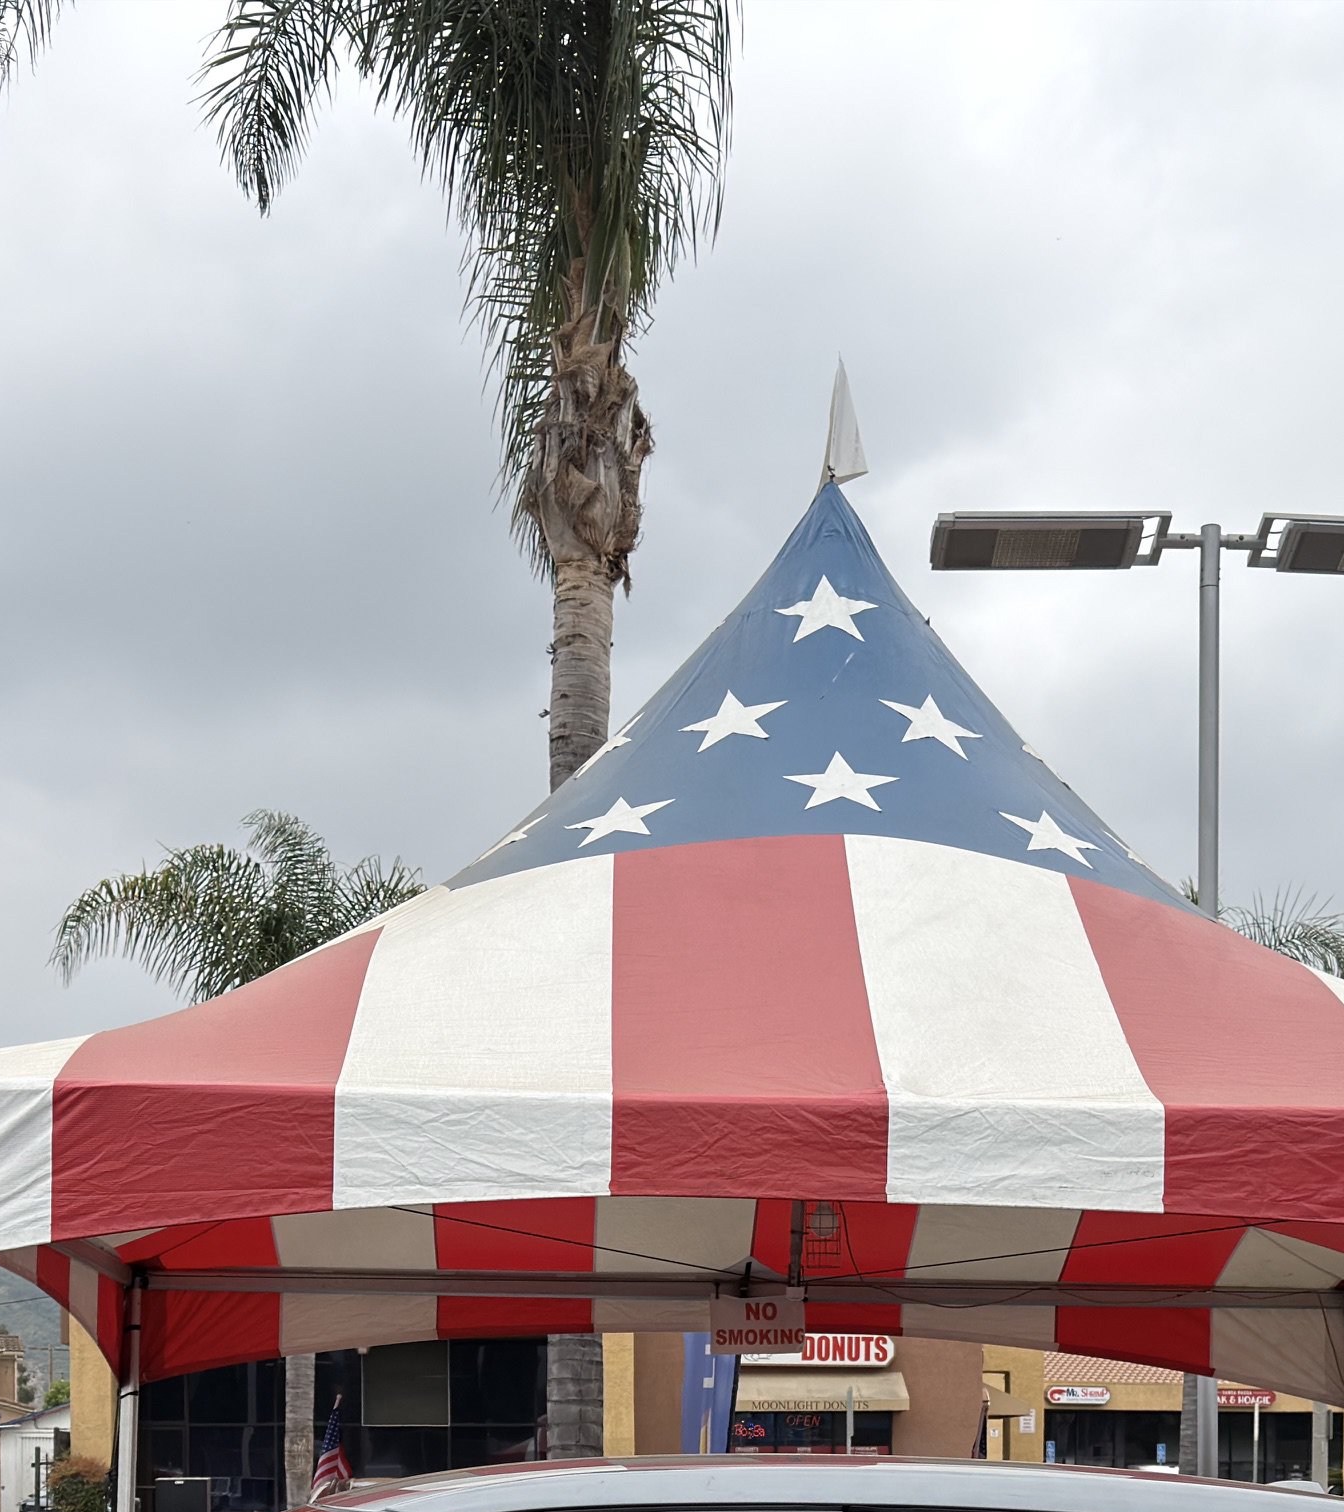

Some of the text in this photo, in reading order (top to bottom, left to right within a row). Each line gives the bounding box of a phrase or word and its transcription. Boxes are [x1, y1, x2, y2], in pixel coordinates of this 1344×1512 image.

[745, 1302, 777, 1321] NO
[715, 1328, 805, 1345] SMOKING
[801, 1335, 888, 1362] DONUTS
[752, 1400, 869, 1410] MOONLIGHT DONTS
[786, 1414, 820, 1426] OPEN
